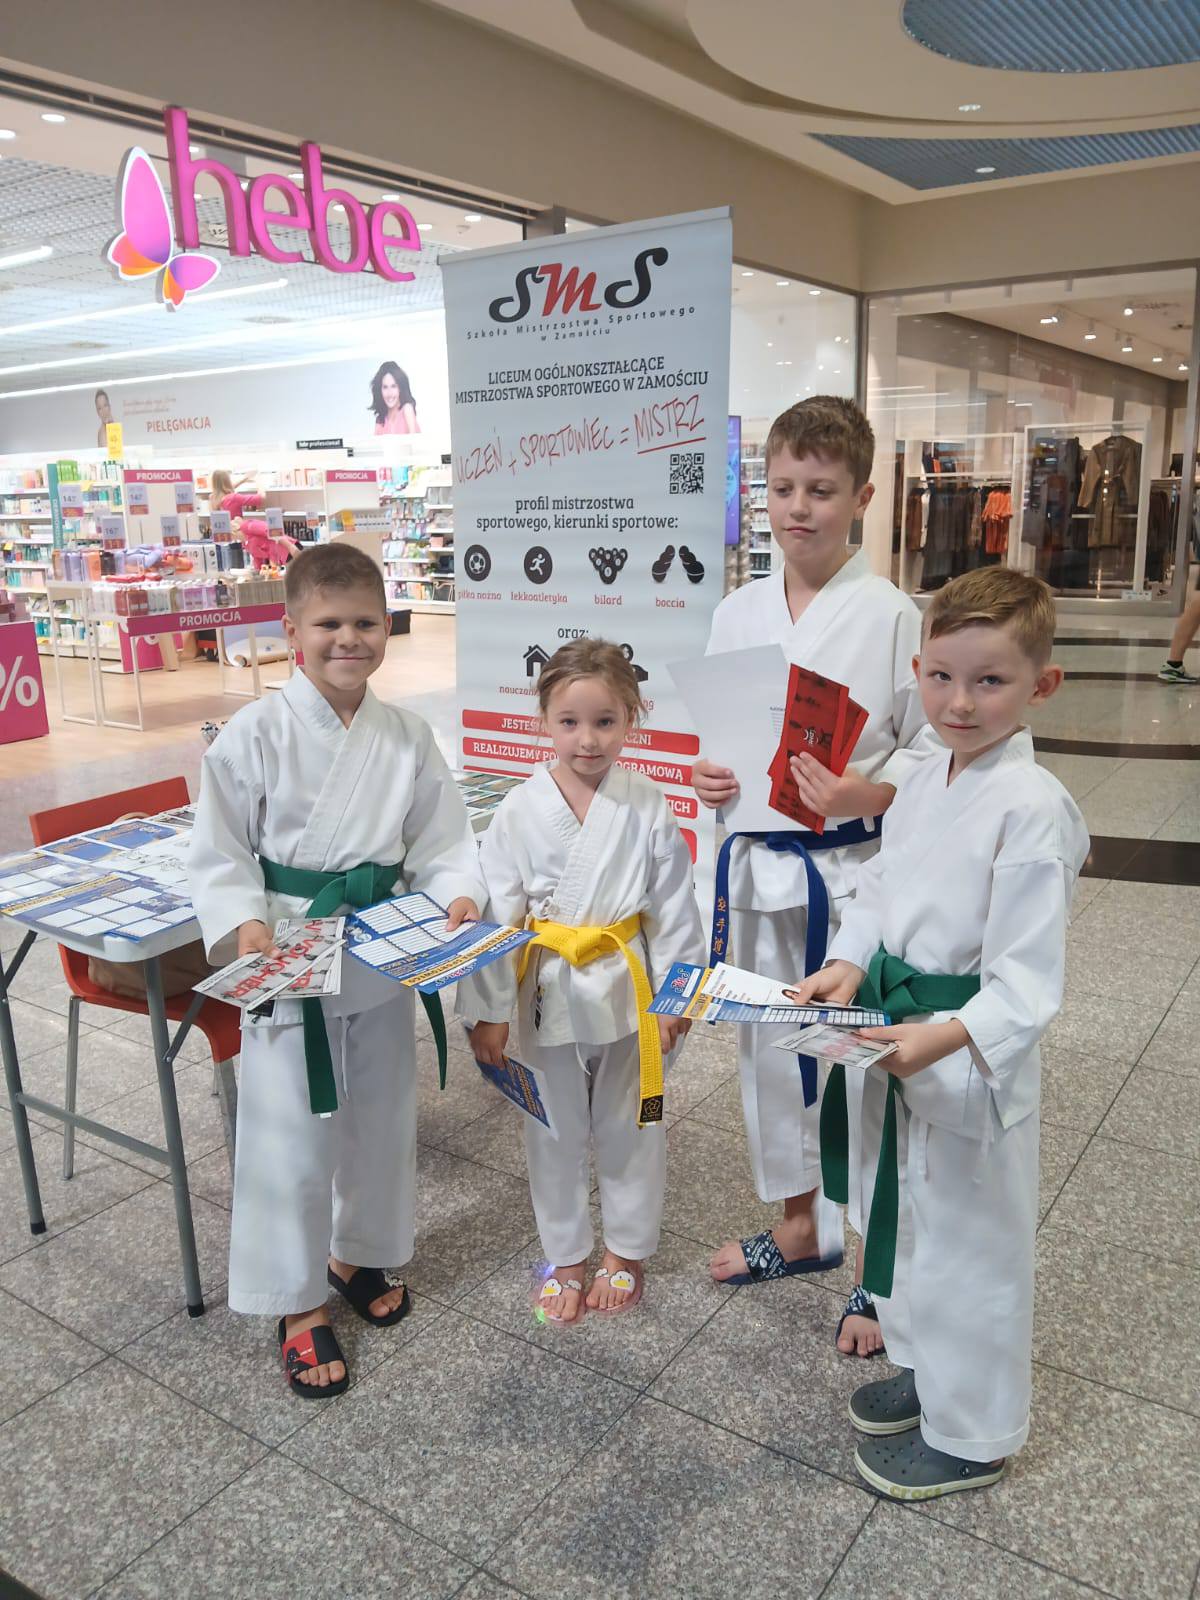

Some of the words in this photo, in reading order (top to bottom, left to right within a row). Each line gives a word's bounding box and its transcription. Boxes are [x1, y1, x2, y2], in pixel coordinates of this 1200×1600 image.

[164, 104, 421, 283] hebe
[467, 328, 507, 340] Szkoła
[516, 318, 599, 334] Mistrzostwa
[609, 306, 695, 324] Sportowego
[488, 369, 532, 385] LICEUM
[534, 356, 665, 381] OGÓLNOKSZTAŁCĄCE
[455, 386, 534, 404] MISTRZOSTWA
[536, 379, 620, 398] SPORTOWEGO
[623, 378, 635, 391] W
[637, 368, 709, 390] ZAMOŚCIU
[146, 416, 211, 434] PIELĘGNACJA
[519, 417, 614, 467] SPORTOWIEC
[634, 394, 705, 447] MISTRZ
[136, 472, 181, 480] PROMOCJA
[335, 472, 368, 480] PROMOCJA
[515, 497, 549, 513] profil
[552, 496, 634, 510] mistrzostwa
[476, 517, 551, 532] sportowego,
[554, 514, 609, 529] kierunki
[612, 514, 679, 531] sportowe:
[510, 592, 568, 604] lekkoatletyka
[594, 595, 622, 606] bilard
[655, 598, 685, 608] boccia
[179, 610, 242, 627] PROMOCJA
[557, 627, 589, 639] oraz:
[501, 717, 544, 733] JESTEŚ
[473, 742, 541, 760] REALIZUJEMY
